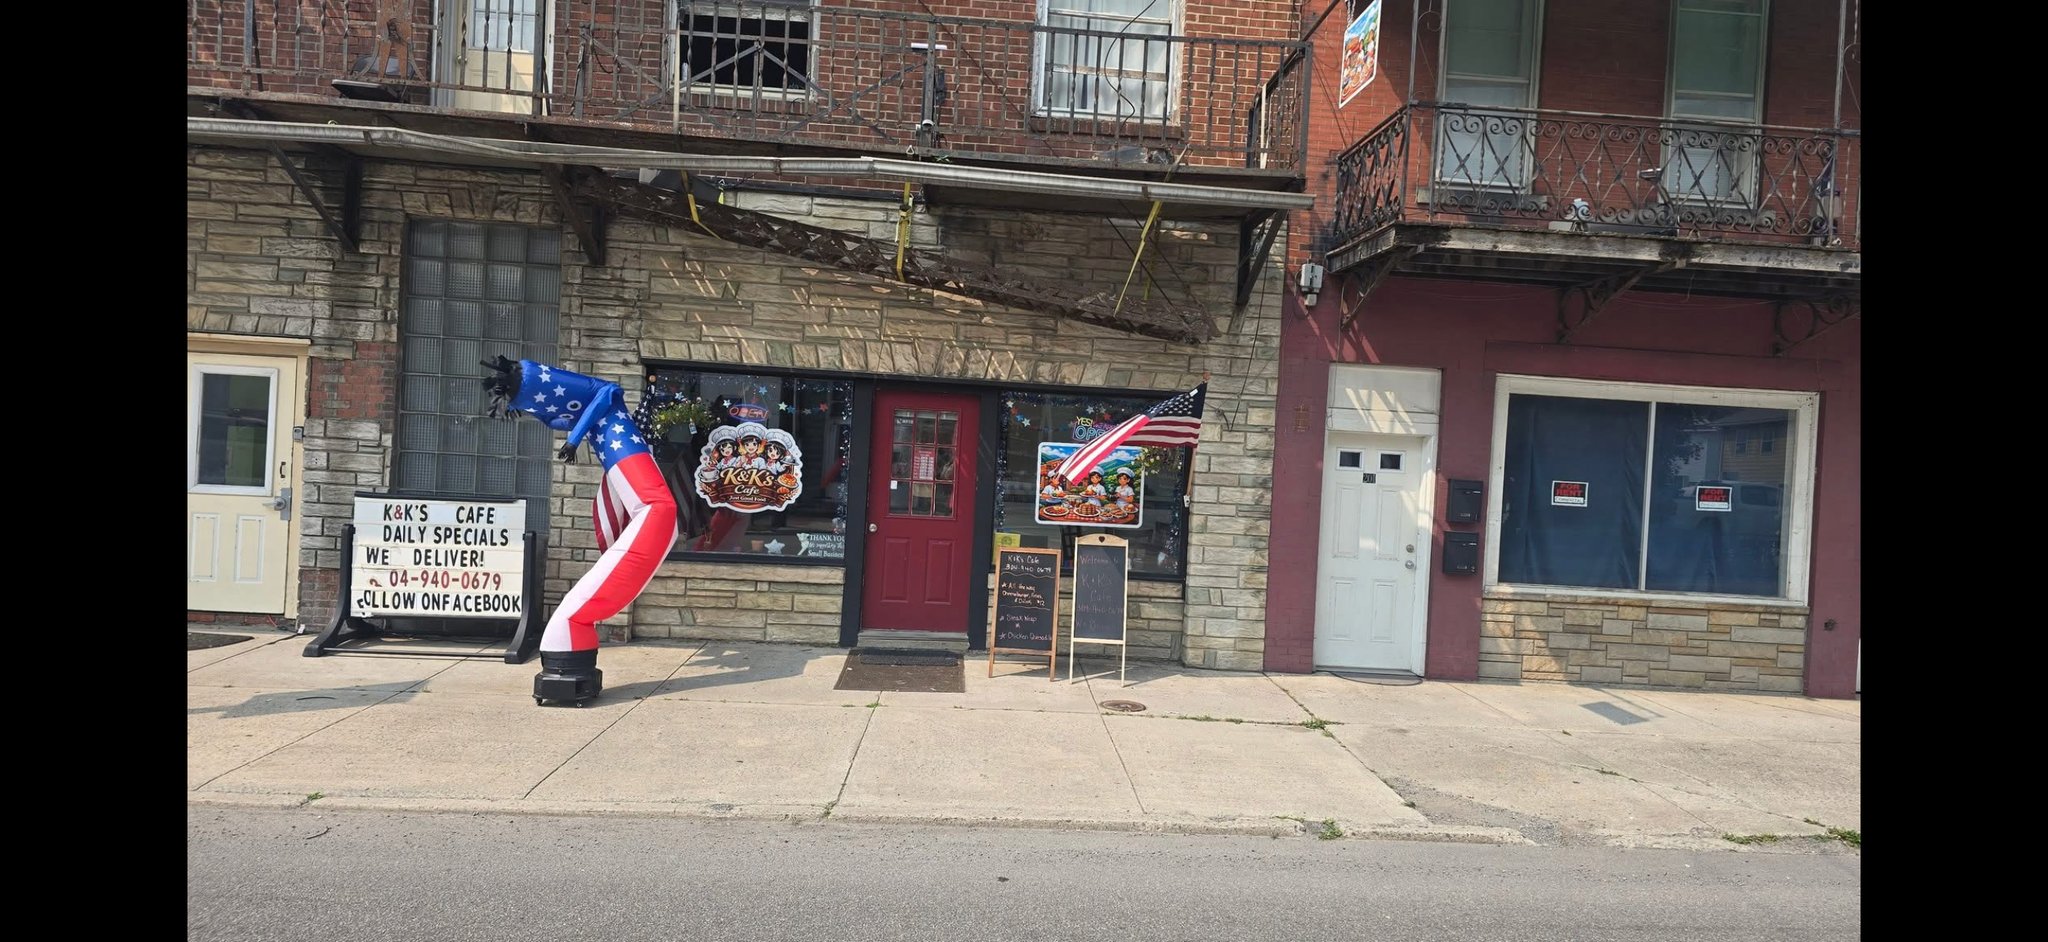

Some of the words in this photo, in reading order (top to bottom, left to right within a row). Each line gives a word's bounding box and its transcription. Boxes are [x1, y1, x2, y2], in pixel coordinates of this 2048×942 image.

[729, 406, 769, 419] OPEN
[720, 467, 774, 487] K&K's
[734, 484, 760, 496] Cafe
[383, 503, 428, 521] K&K'S
[456, 506, 495, 524] CAFE
[383, 525, 426, 544] DAILY
[433, 526, 509, 546] SPECIALS
[810, 534, 833, 542] THANK
[366, 547, 389, 565] WE
[413, 548, 484, 567] DELIVER!
